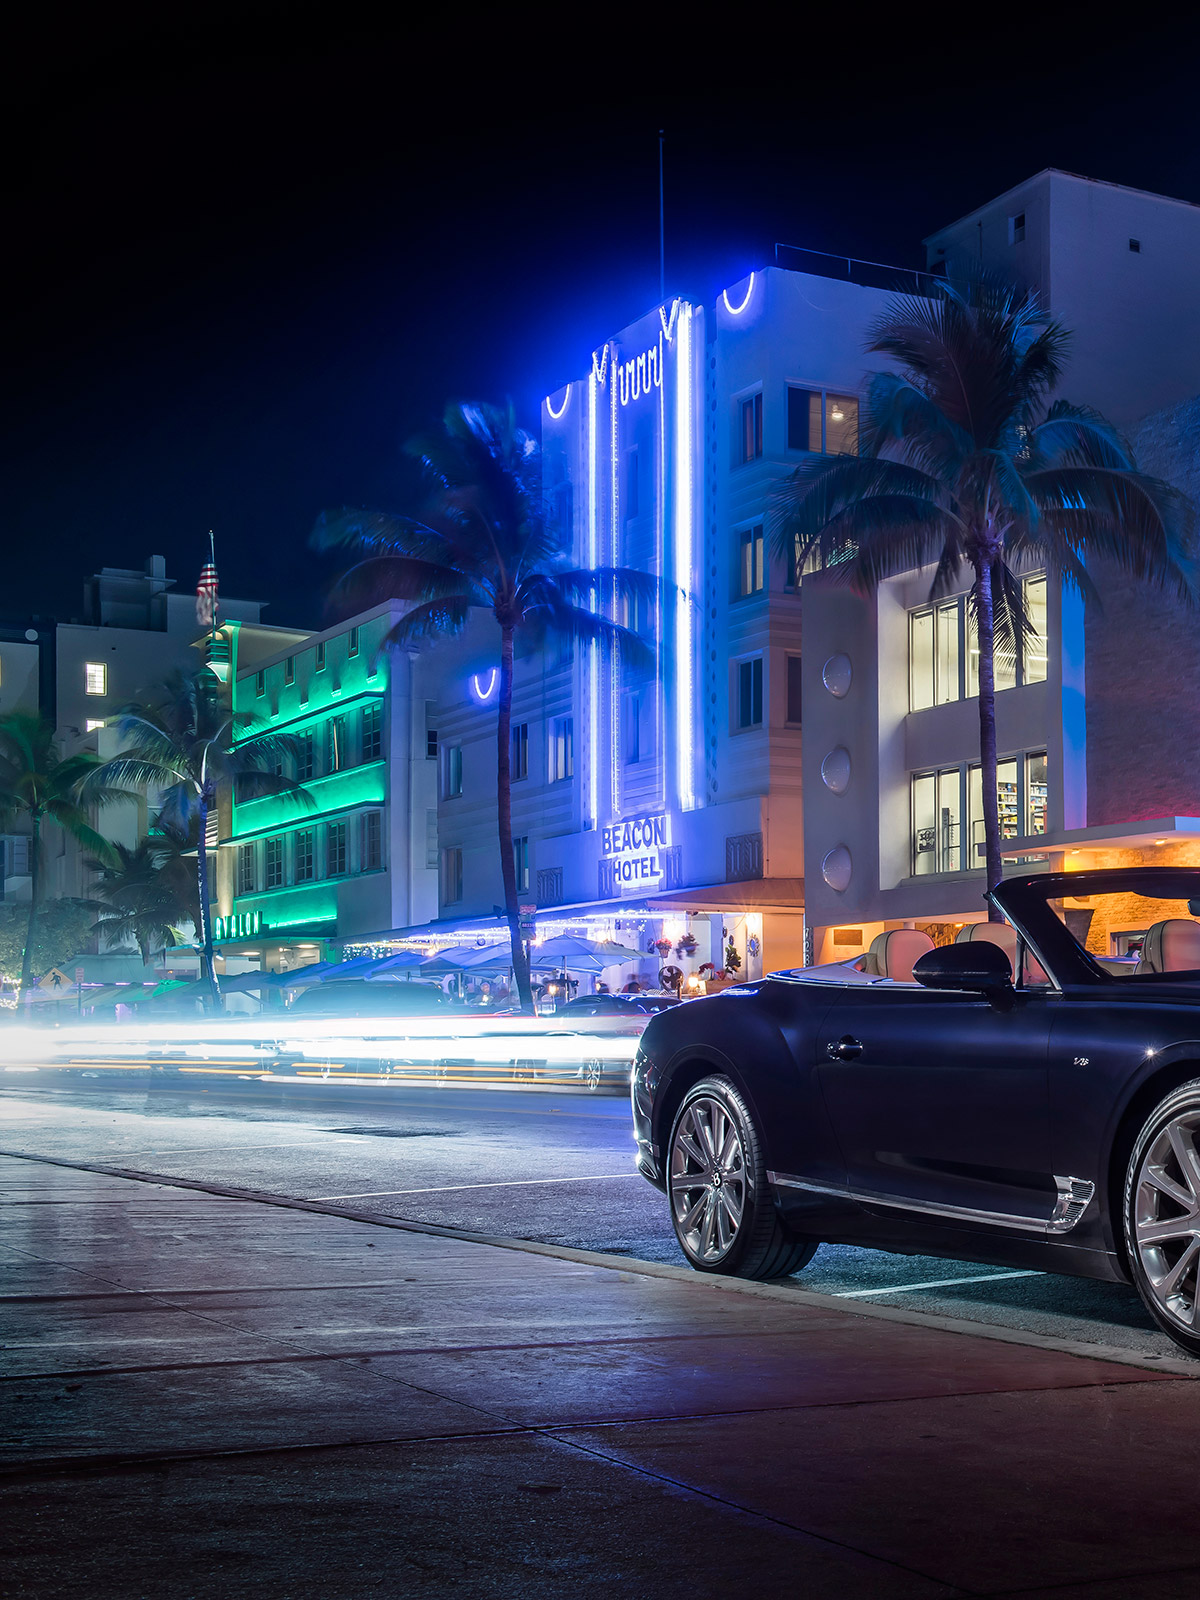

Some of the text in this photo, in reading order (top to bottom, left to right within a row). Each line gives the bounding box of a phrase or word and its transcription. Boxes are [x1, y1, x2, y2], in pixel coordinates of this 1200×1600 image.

[602, 816, 667, 855] BEACON
[613, 856, 660, 882] HOTEL
[215, 910, 260, 940] AVALON
